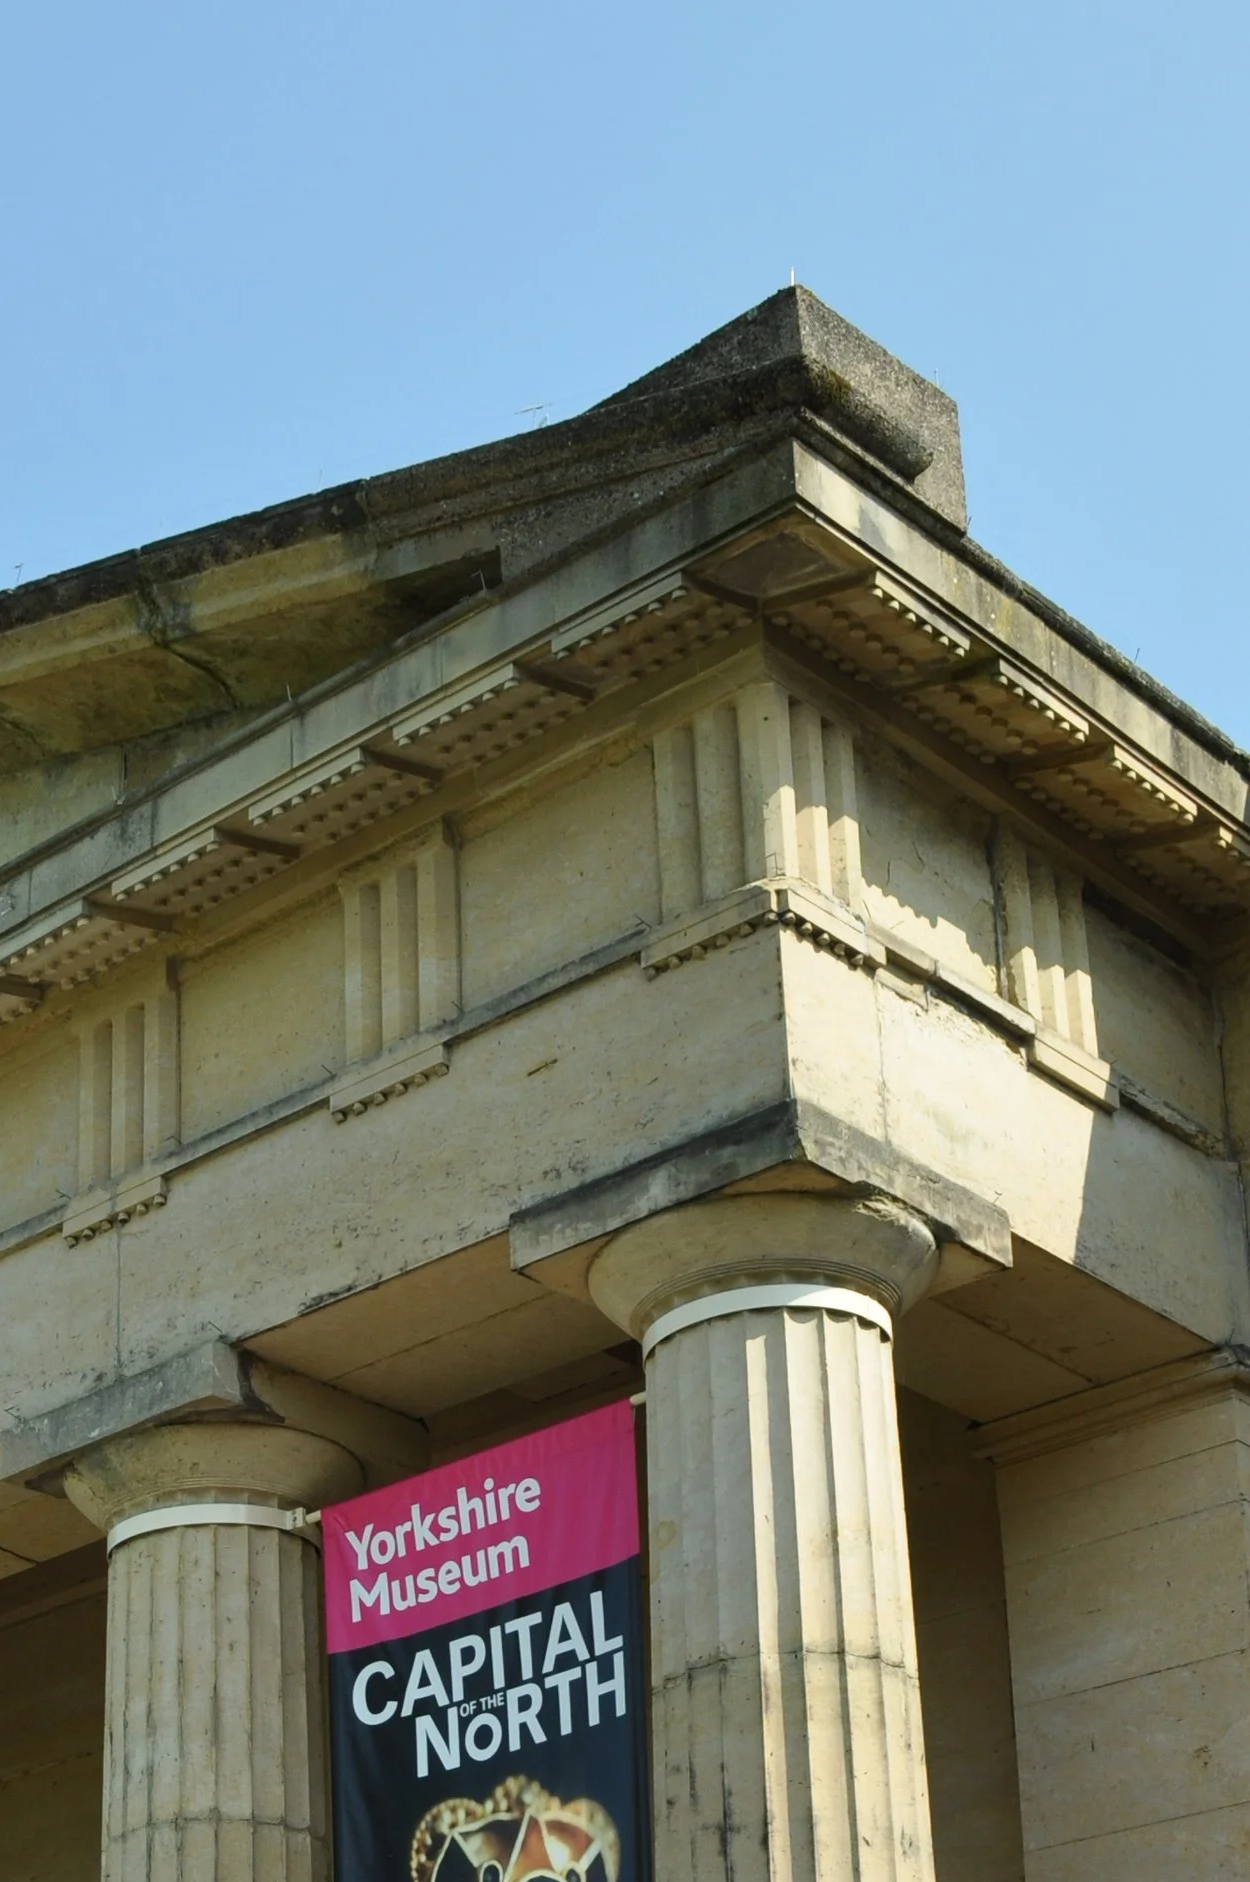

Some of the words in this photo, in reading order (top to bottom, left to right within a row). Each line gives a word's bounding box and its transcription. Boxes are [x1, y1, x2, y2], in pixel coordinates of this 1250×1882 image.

[345, 1477, 541, 1570] Yorkshire
[349, 1535, 529, 1622] Museum
[352, 1590, 624, 1726] CAPITAL
[460, 1701, 477, 1717] OF
[479, 1692, 505, 1711] THE
[416, 1651, 626, 1777] NORTH
